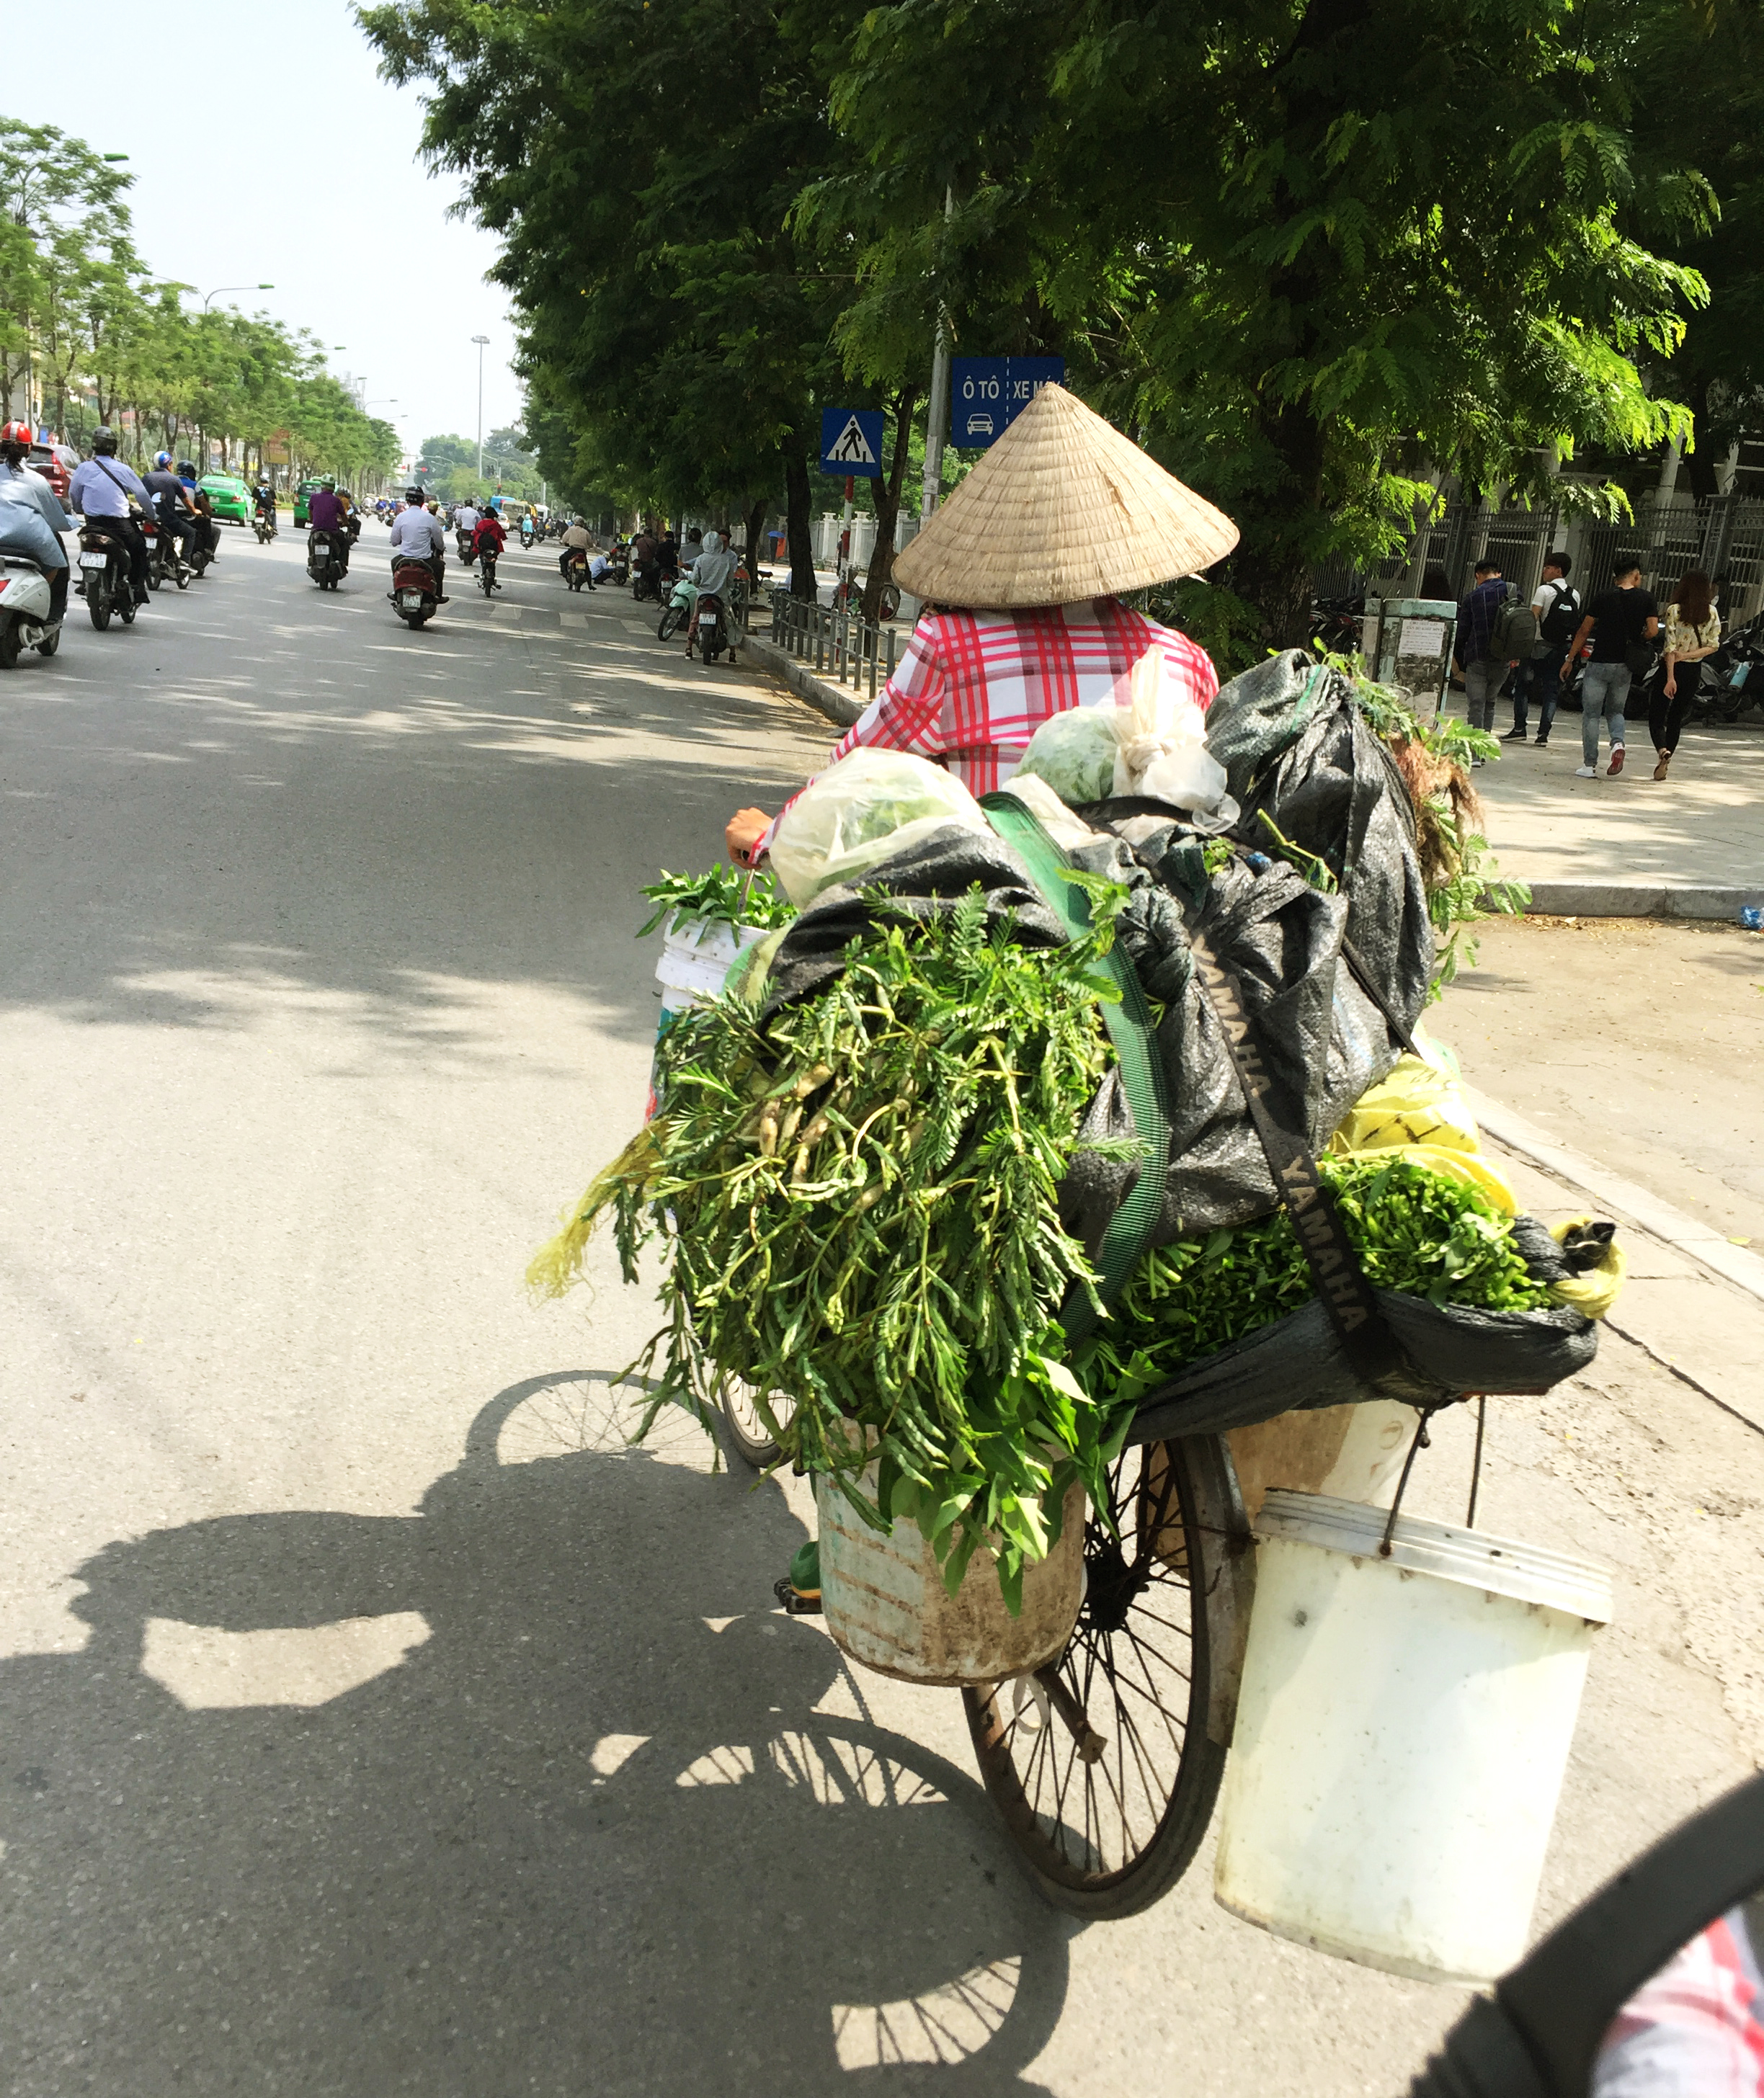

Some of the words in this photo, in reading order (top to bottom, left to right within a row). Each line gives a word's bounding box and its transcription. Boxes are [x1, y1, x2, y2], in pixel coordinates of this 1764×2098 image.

[963, 375, 974, 399] Ô
[978, 375, 999, 399] TÔ
[1012, 380, 1030, 399] XE
[1190, 934, 1272, 1098] YAMAHA
[1280, 1155, 1368, 1332] YAMAHA
